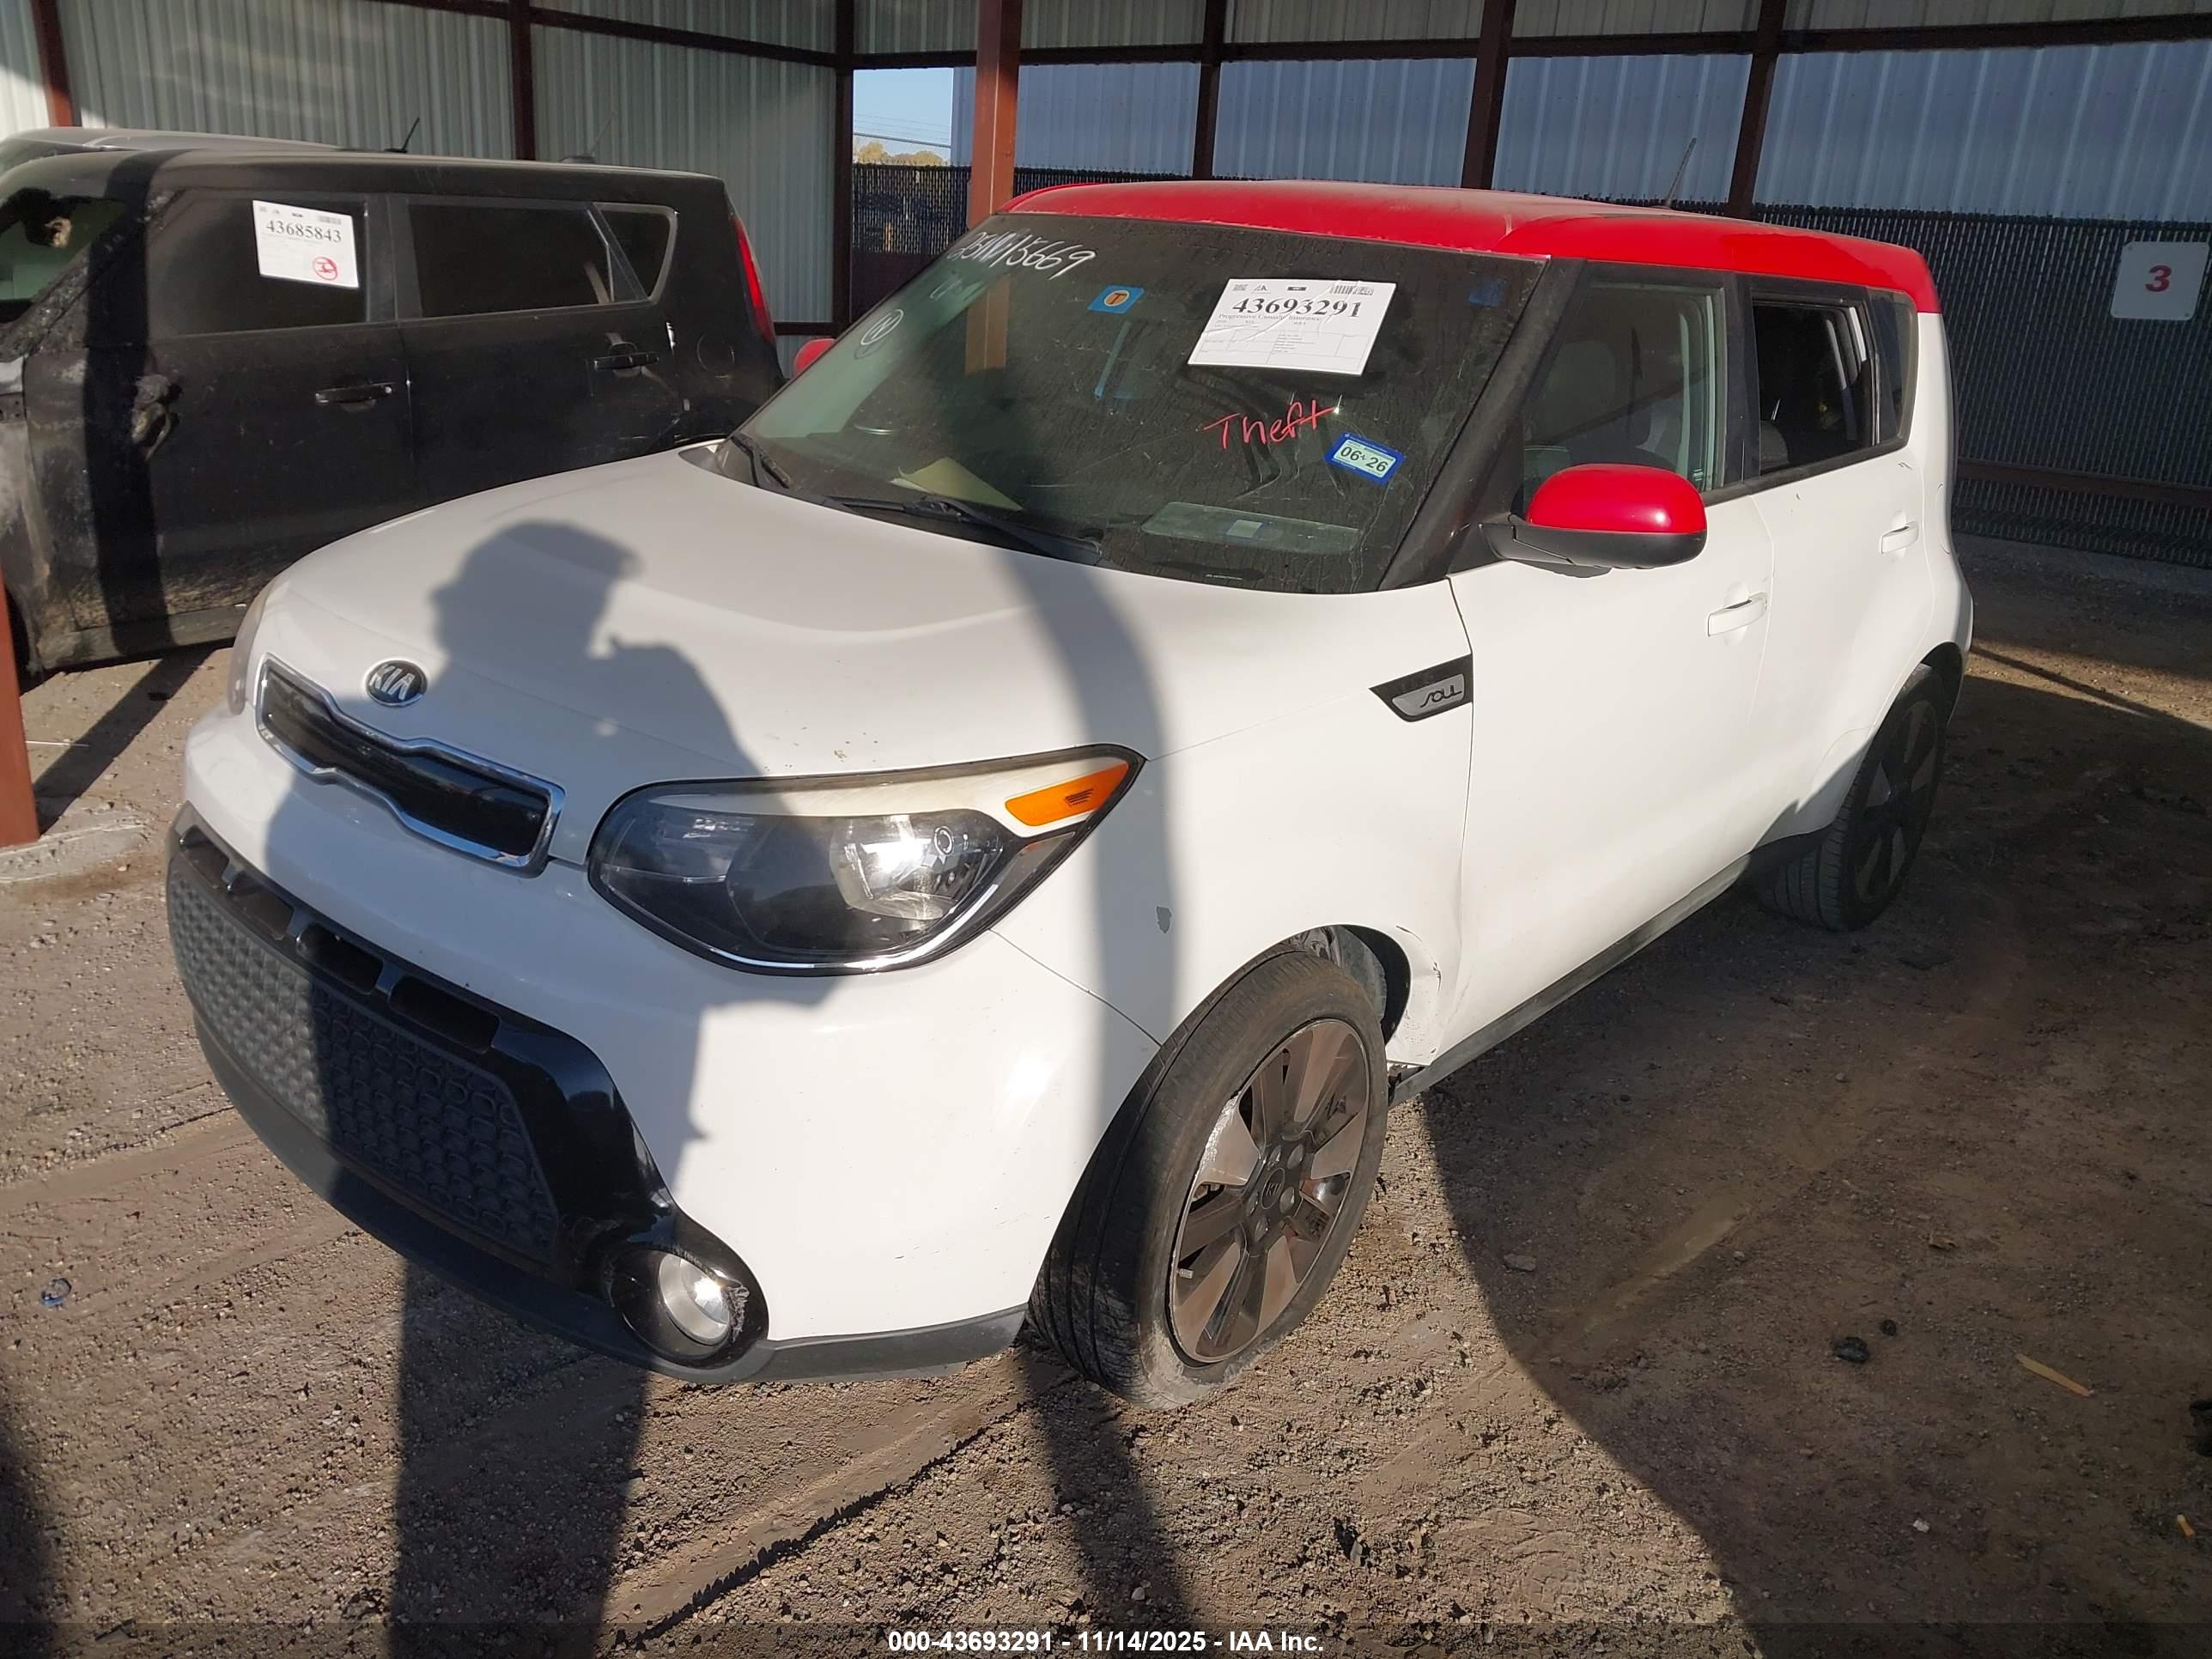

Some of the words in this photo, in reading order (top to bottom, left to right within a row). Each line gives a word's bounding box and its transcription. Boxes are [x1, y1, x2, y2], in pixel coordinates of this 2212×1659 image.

[266, 220, 342, 242] 43685843
[2145, 264, 2172, 292] 3
[1232, 298, 1361, 318] 43693291
[1203, 399, 1336, 450] Theft
